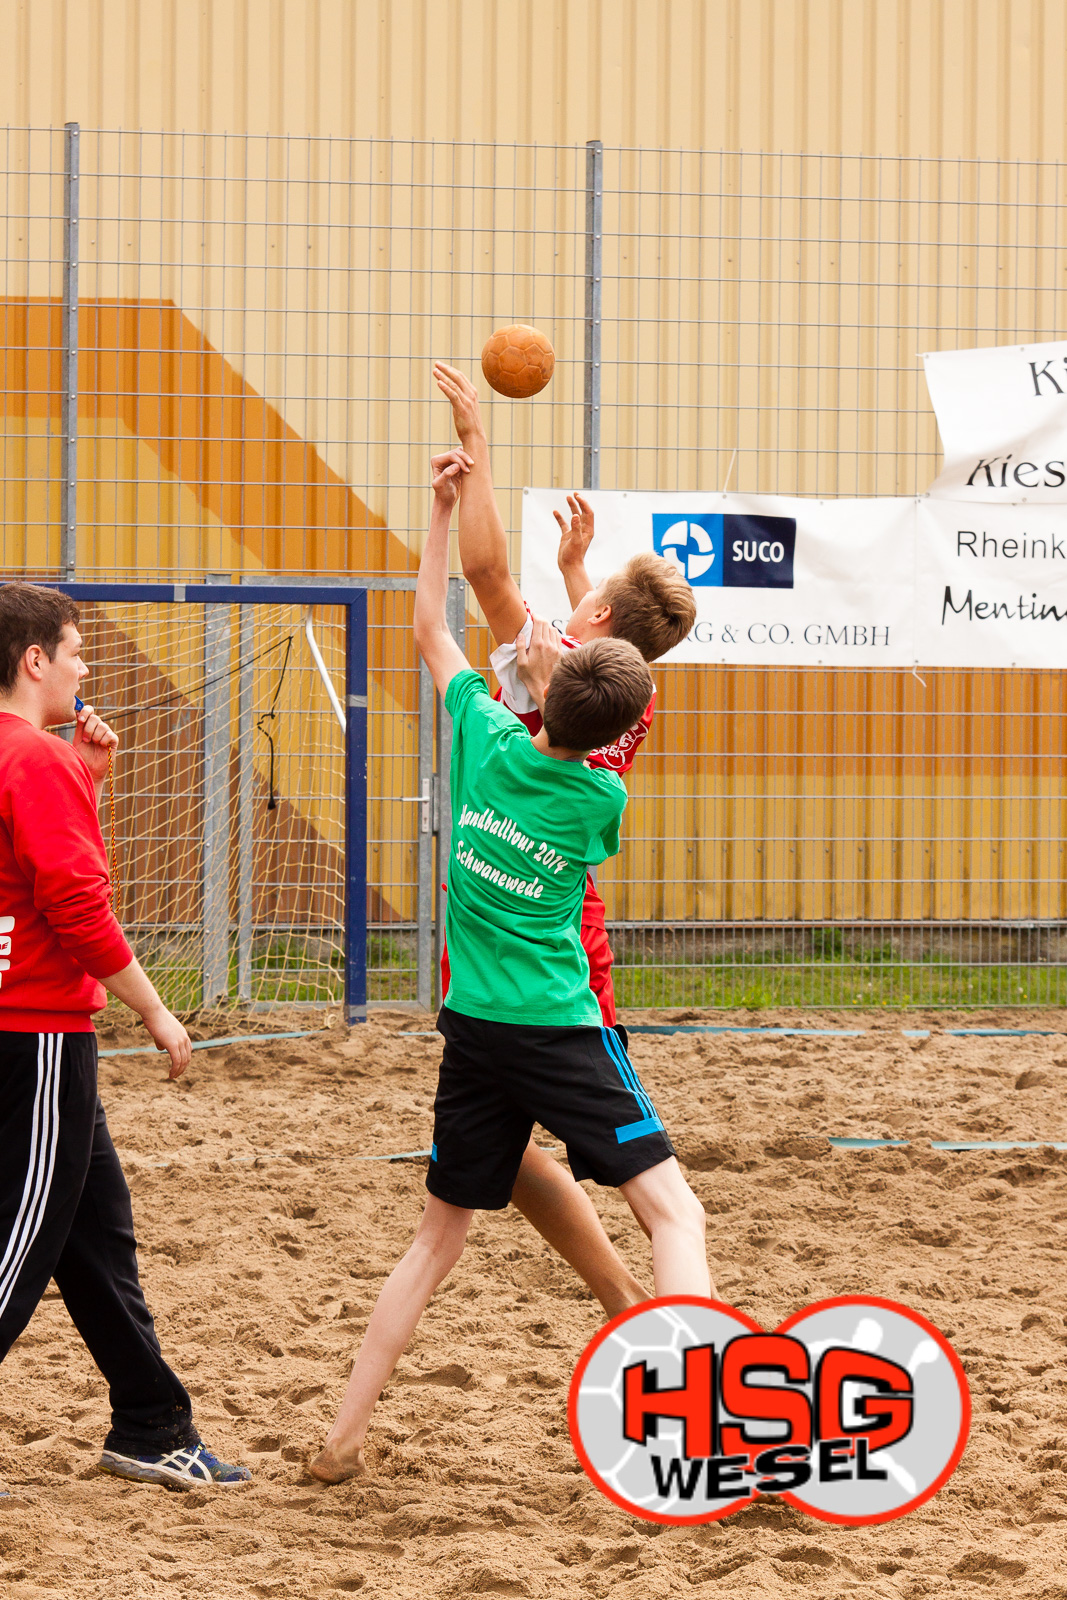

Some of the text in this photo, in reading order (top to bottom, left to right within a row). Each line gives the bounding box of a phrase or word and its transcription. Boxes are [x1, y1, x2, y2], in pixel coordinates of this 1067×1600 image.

[732, 540, 785, 563] SUCO
[941, 585, 1067, 626] Mentin
[721, 624, 740, 644] &
[747, 623, 794, 645] CO.
[803, 624, 890, 646] GMBH
[458, 803, 569, 875] Handballtour 2014
[456, 840, 544, 899] Schwanewede
